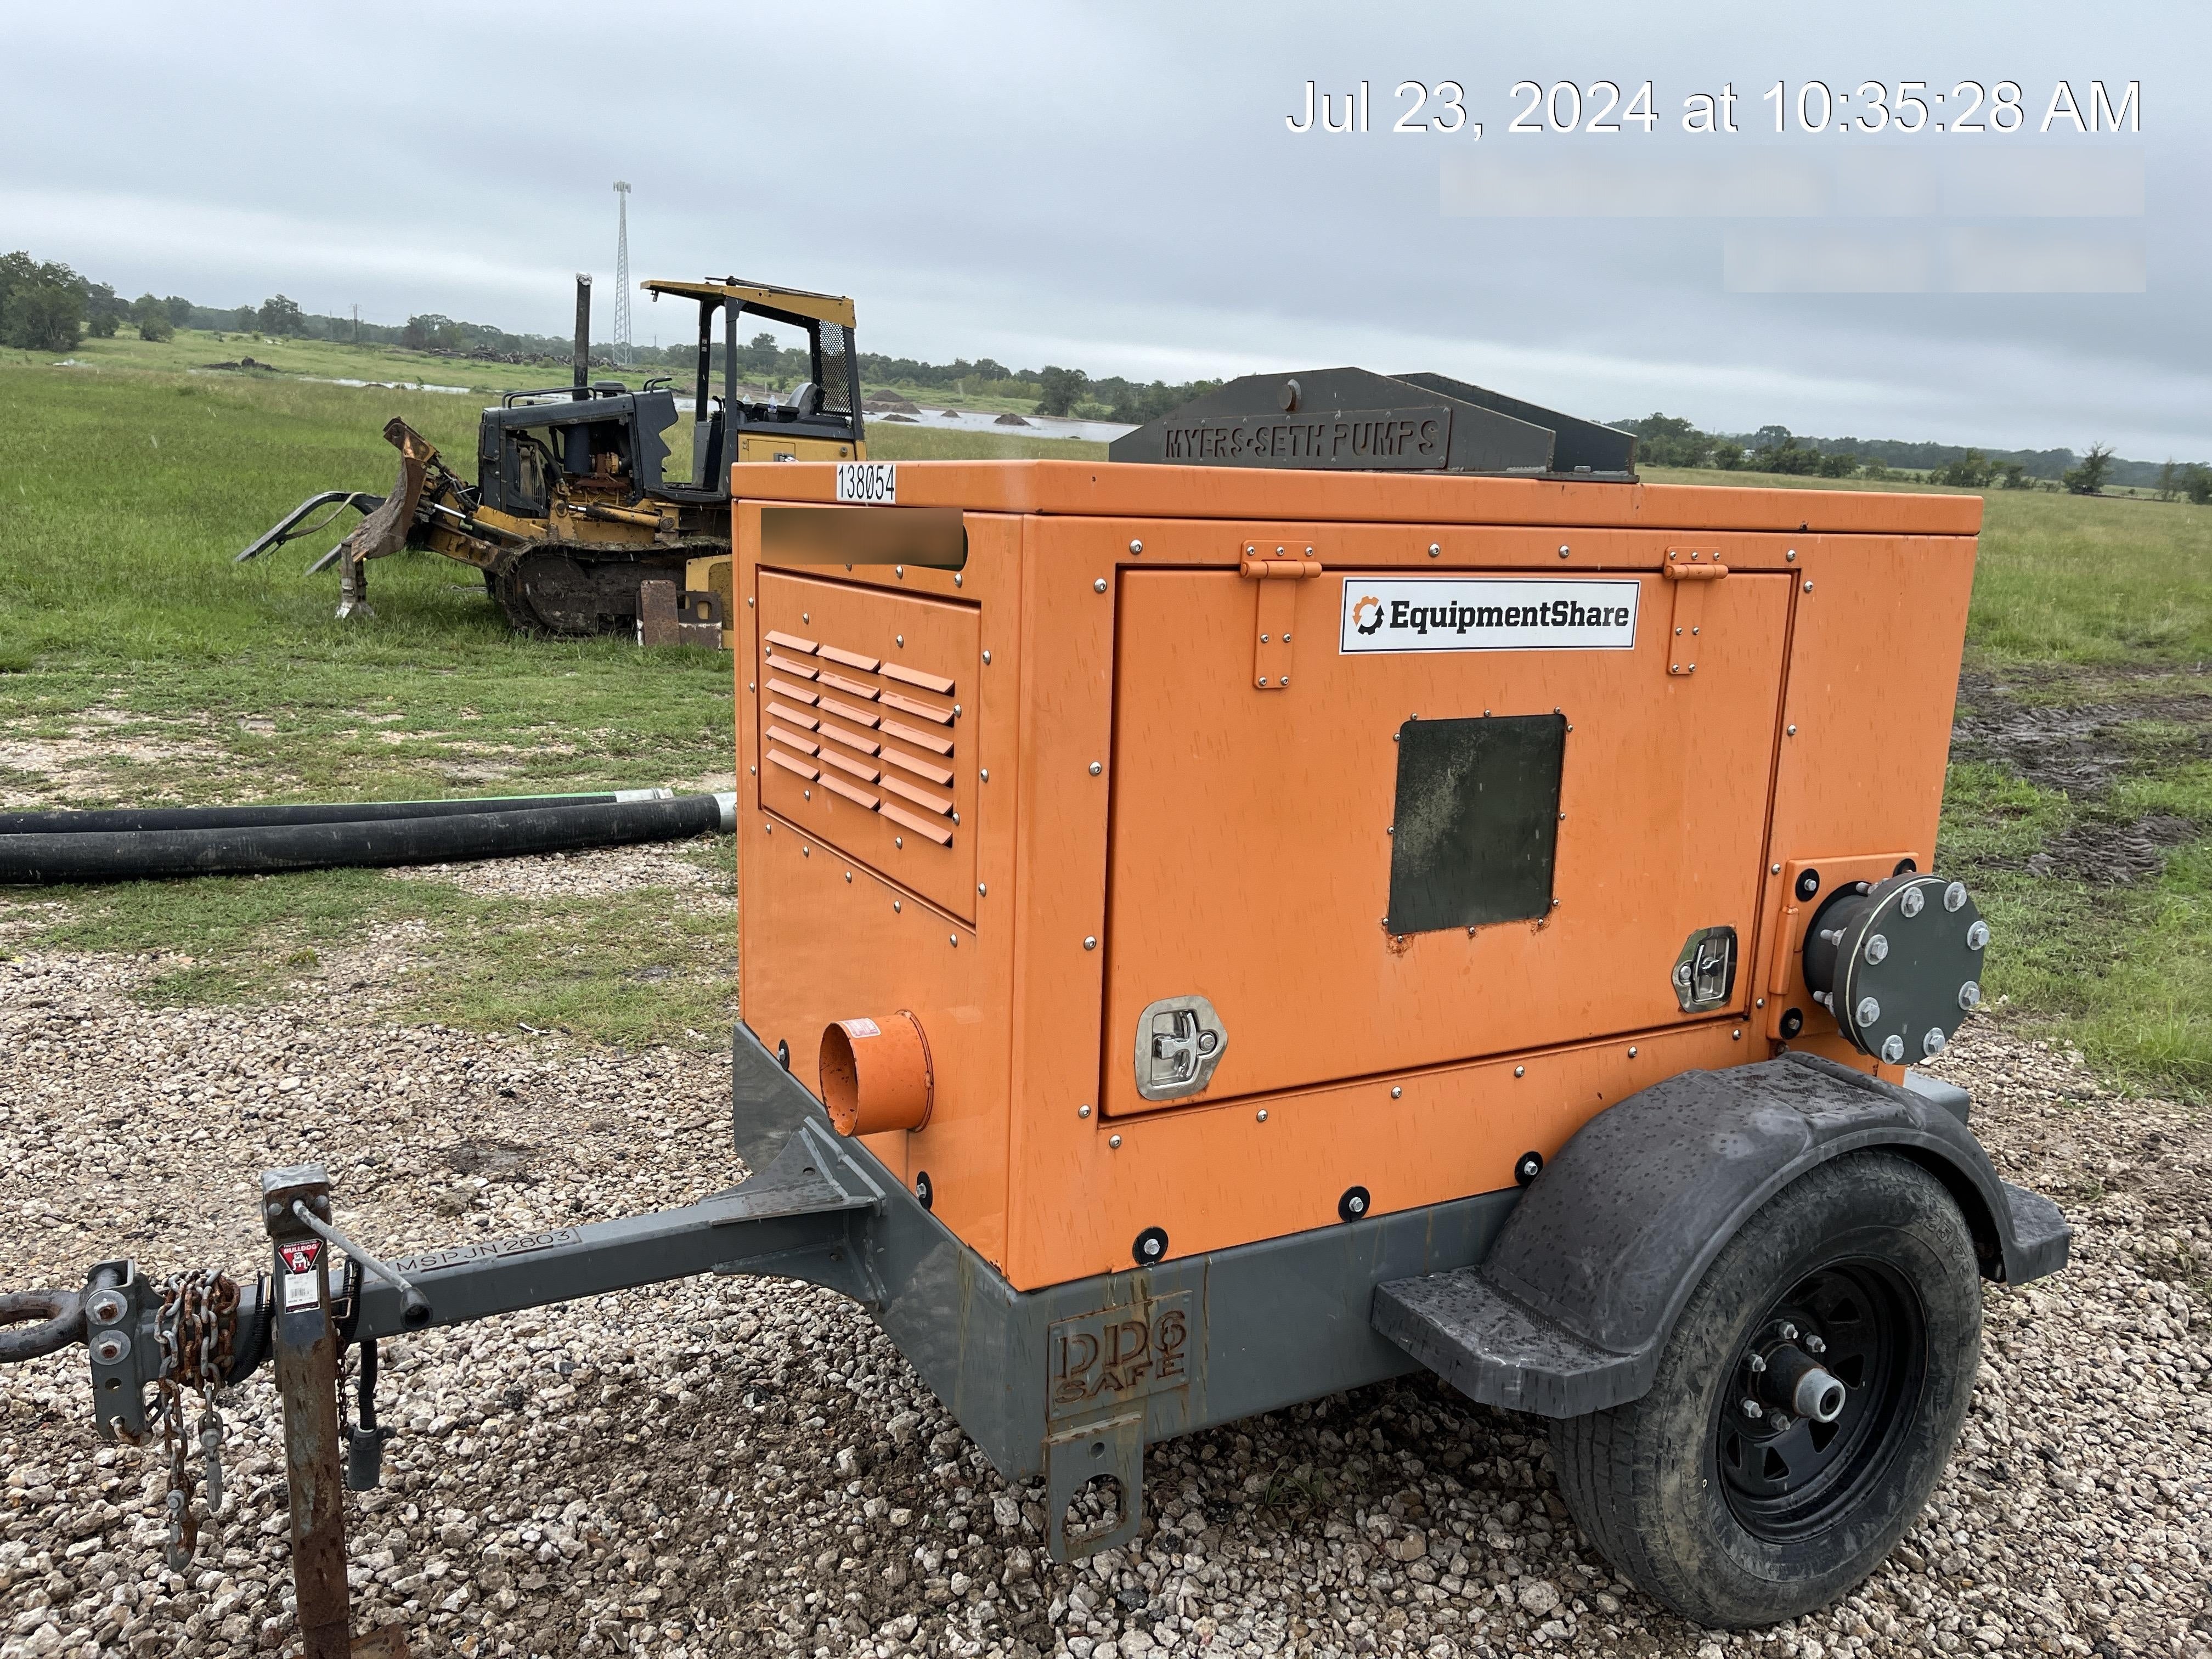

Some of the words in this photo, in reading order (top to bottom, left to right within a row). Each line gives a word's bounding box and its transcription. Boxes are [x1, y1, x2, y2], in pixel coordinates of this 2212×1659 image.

[1333, 420, 1440, 456] PUMPS
[838, 465, 895, 500] 138054
[1390, 600, 1629, 635] EquipmentShare
[284, 1244, 317, 1254] BULLDOG
[1054, 1352, 1185, 1404] SAFE
